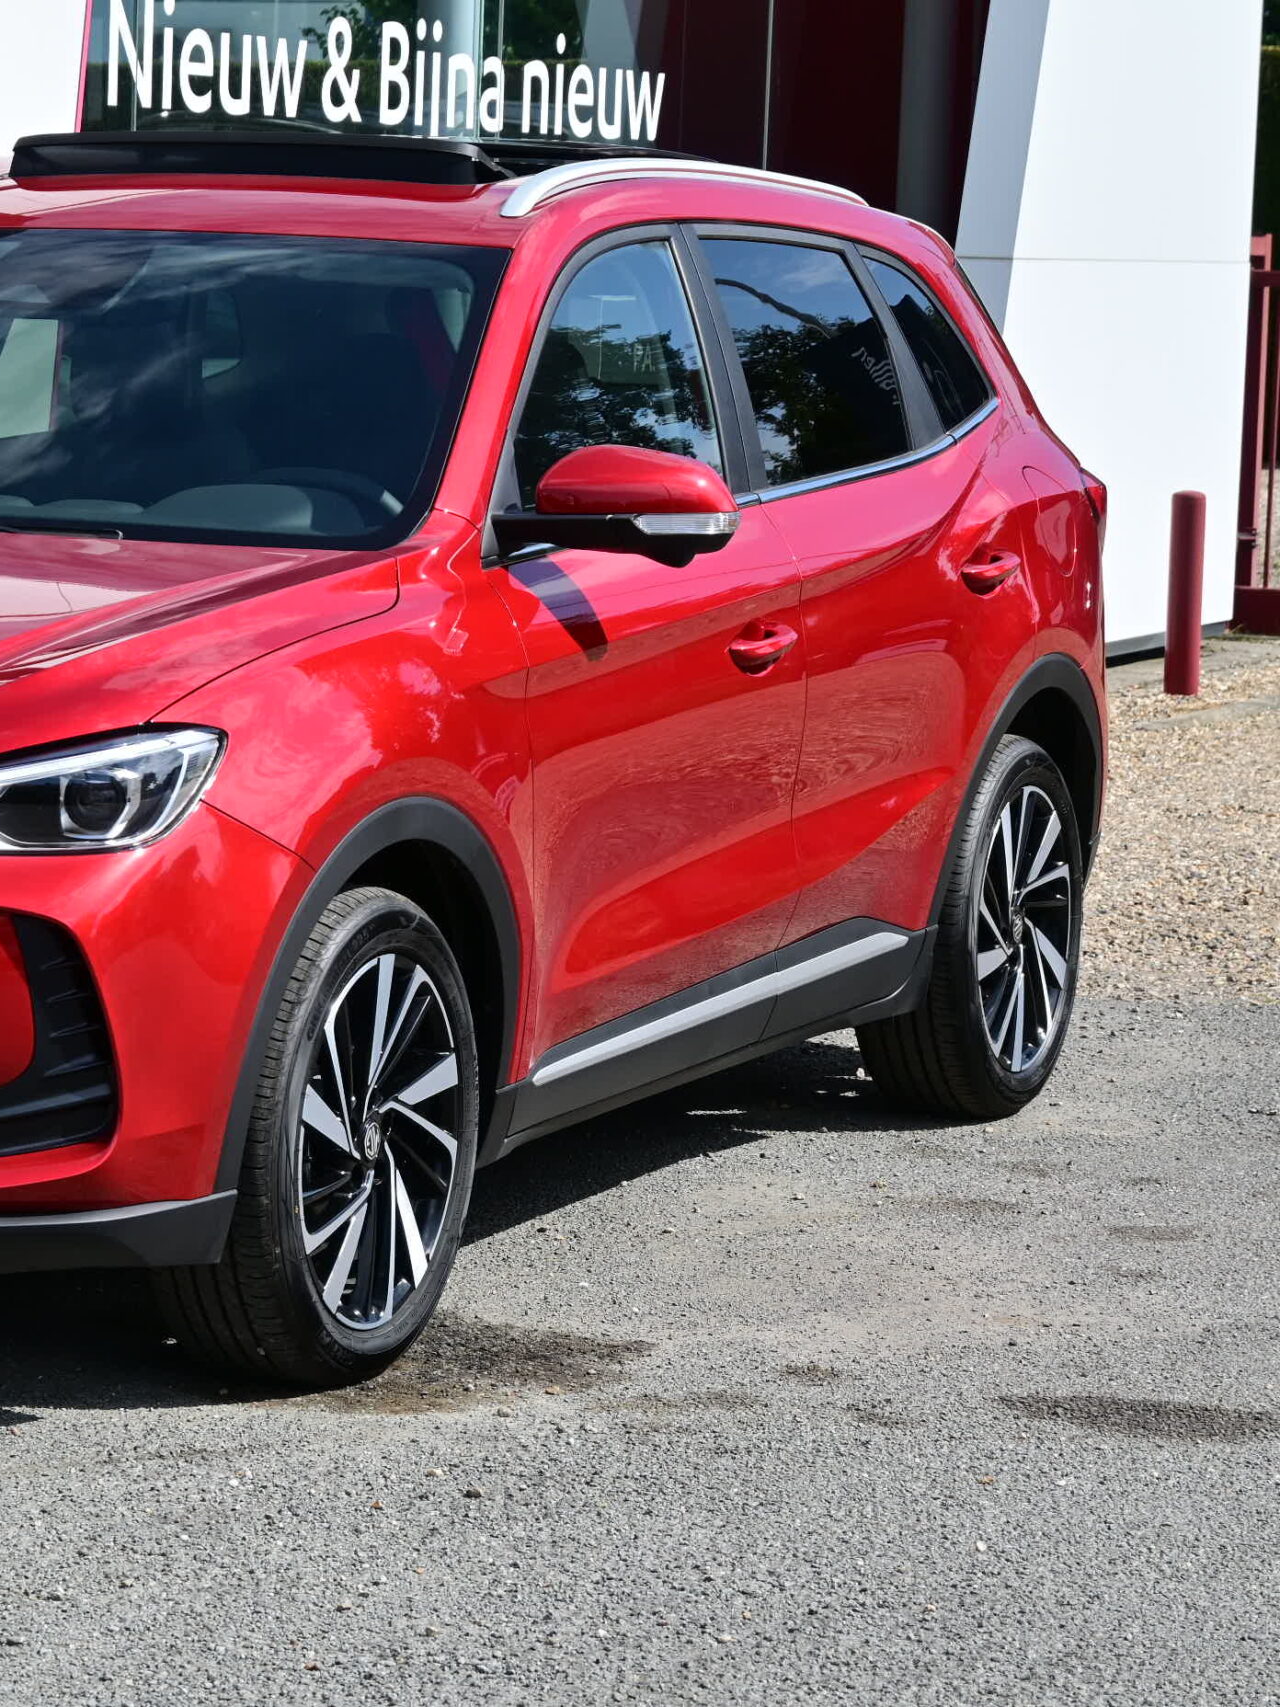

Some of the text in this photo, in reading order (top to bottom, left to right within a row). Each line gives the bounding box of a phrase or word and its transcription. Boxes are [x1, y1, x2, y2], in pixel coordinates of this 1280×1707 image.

[106, 0, 666, 142] Nieuw & Bijna nieuw
